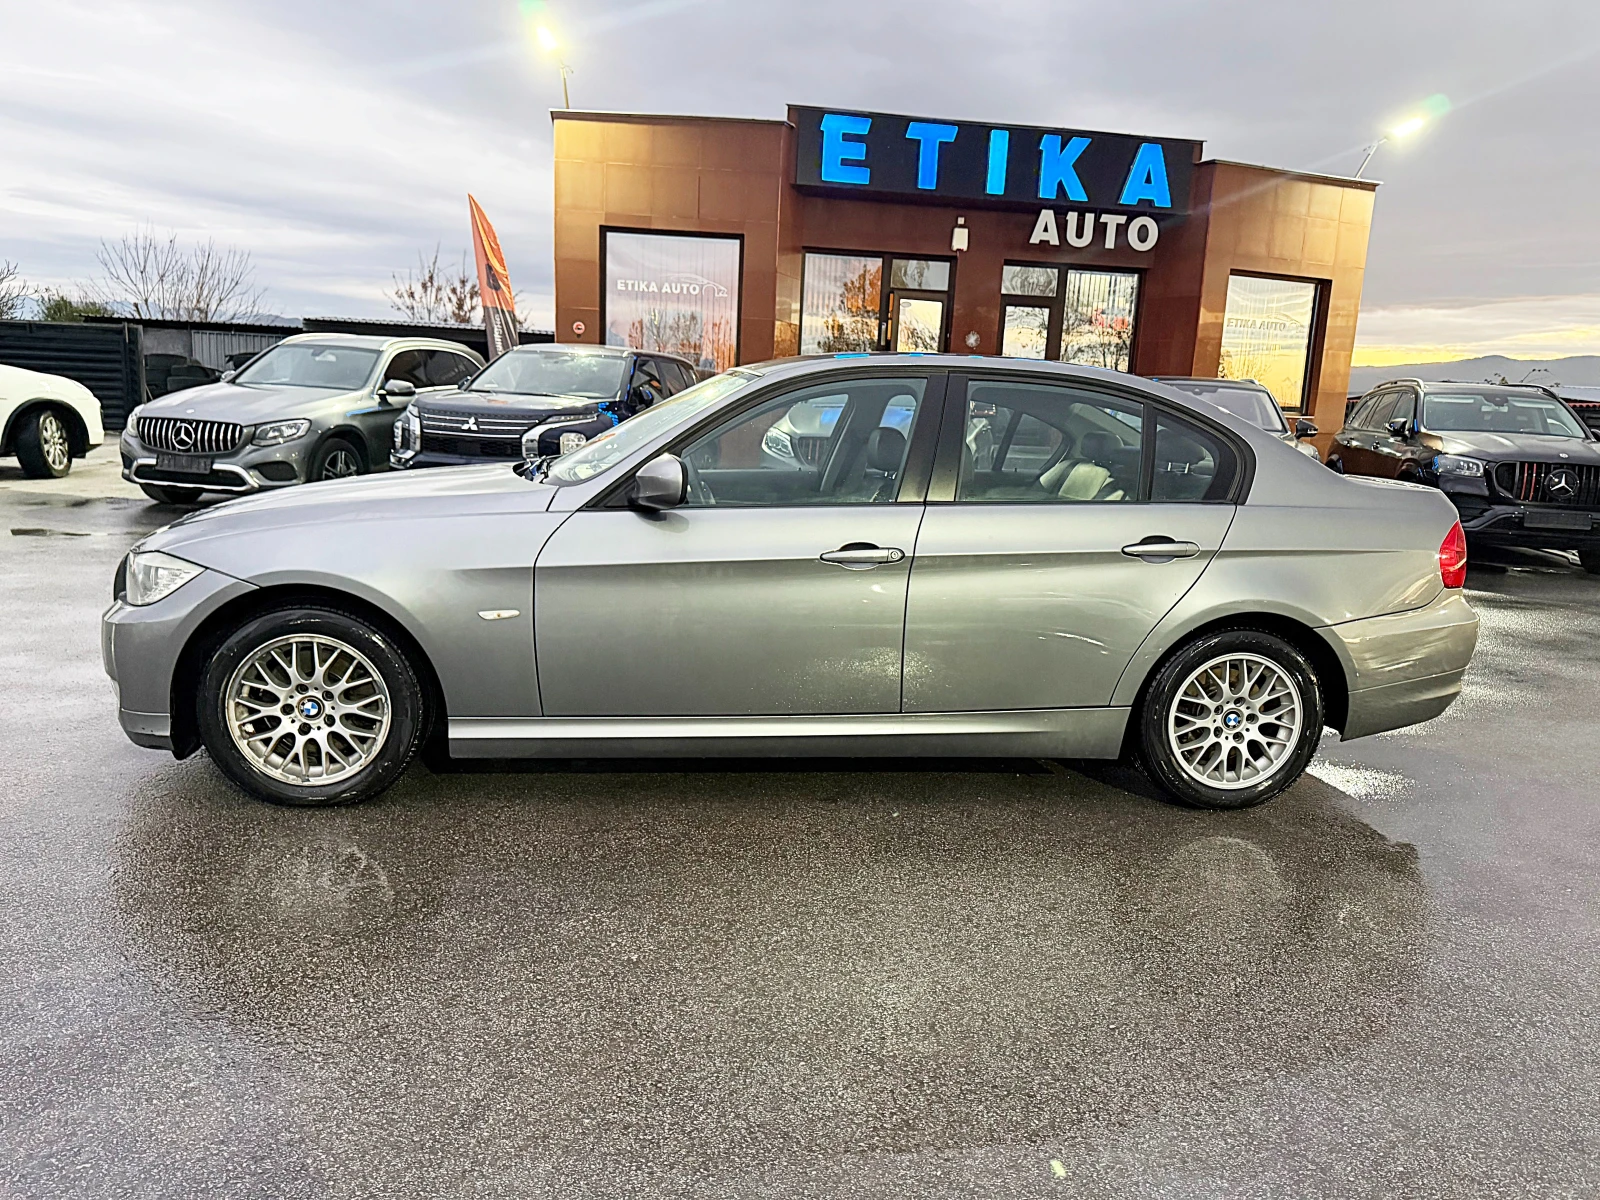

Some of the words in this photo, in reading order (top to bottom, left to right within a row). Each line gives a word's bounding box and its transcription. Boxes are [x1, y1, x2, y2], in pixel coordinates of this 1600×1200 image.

[820, 113, 1172, 208] ETIKA
[1029, 209, 1158, 251] AUTO
[616, 279, 658, 293] ETIKA
[661, 282, 700, 295] AUTO
[1226, 317, 1257, 329] ETIKA
[1258, 320, 1286, 332] AUTO
